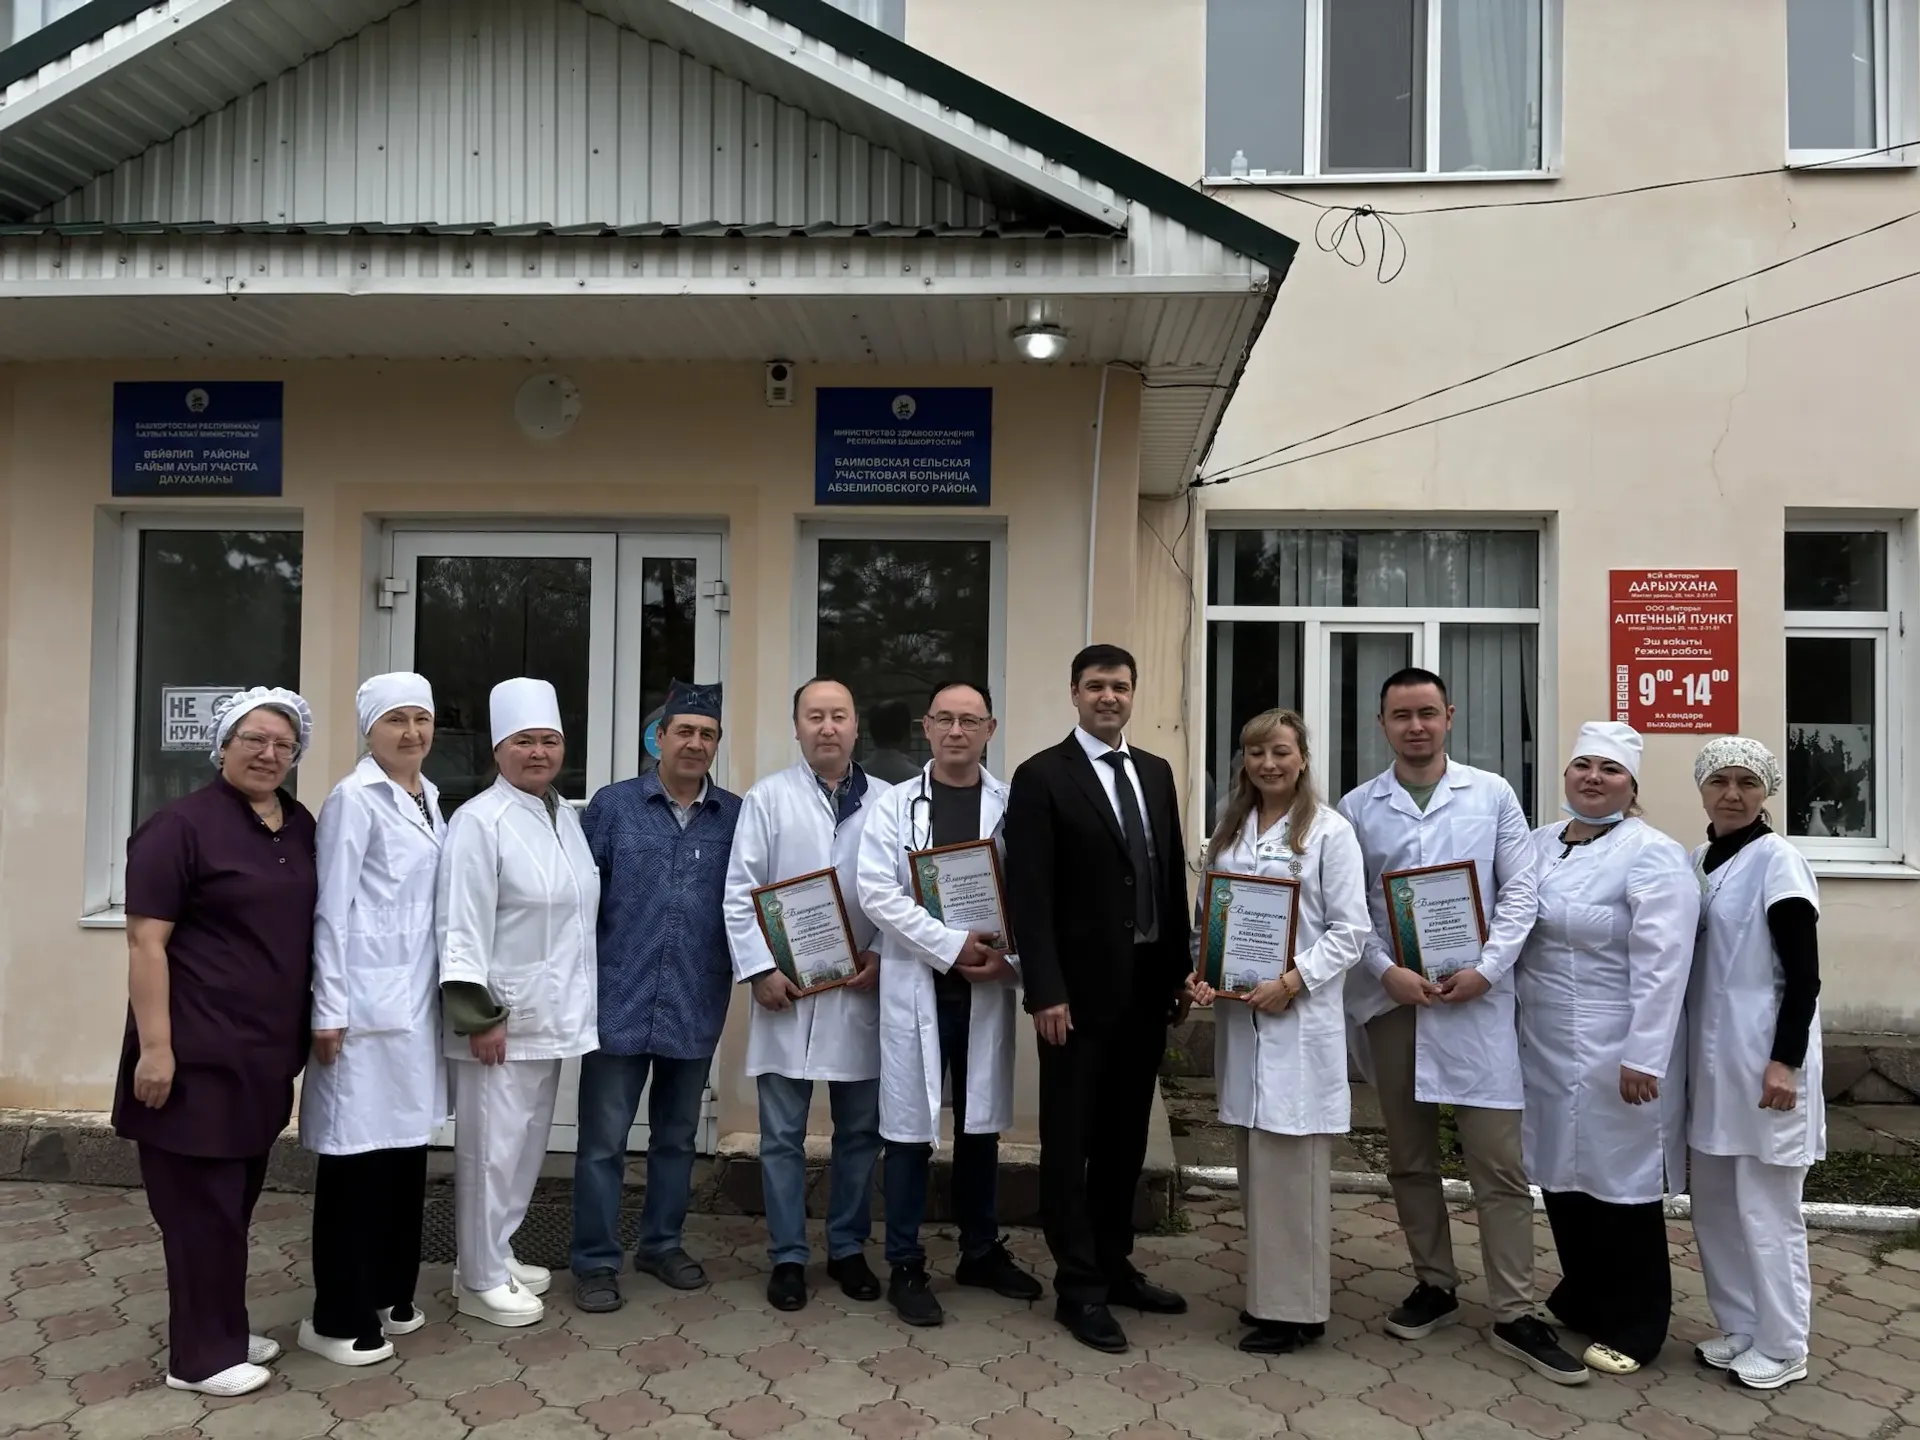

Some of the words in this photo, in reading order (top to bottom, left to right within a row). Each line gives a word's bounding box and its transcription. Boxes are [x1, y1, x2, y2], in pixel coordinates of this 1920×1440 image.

[833, 429, 896, 437] МИНИСТЕРСТВО
[897, 429, 975, 438] ЗДРАВООХРАНЕНИЯ
[846, 437, 897, 446] РЕСПУБЛИКИ
[898, 438, 962, 446] БАШКОРТОСТАН
[202, 448, 250, 459] РАЙОНЫ
[134, 461, 175, 471] БАЙЫМ
[177, 462, 208, 471] АУЫЛ
[210, 462, 259, 472] УЧАСТКА
[834, 457, 910, 467] БАИМОВСКАЯ
[912, 458, 971, 468] СЕЛЬСКАЯ
[835, 470, 907, 480] УЧАСТКОВАЯ
[909, 470, 971, 481] БОЛЬНИЦА
[827, 483, 930, 493] АБЗЕЛИЛОВСКОГО
[932, 482, 978, 493] РАЙОНА
[1628, 581, 1718, 592] ДАРЫУХАНА
[1615, 612, 1686, 624] АПТЕЧНЫЙ
[1691, 613, 1733, 624] ПУНКТ
[1643, 637, 1661, 645] Эш
[1635, 647, 1670, 655] Режим
[1671, 647, 1711, 656] работы
[170, 697, 197, 718] НЕ
[170, 725, 209, 740] КУРИ
[1229, 904, 1287, 921] Благодарность
